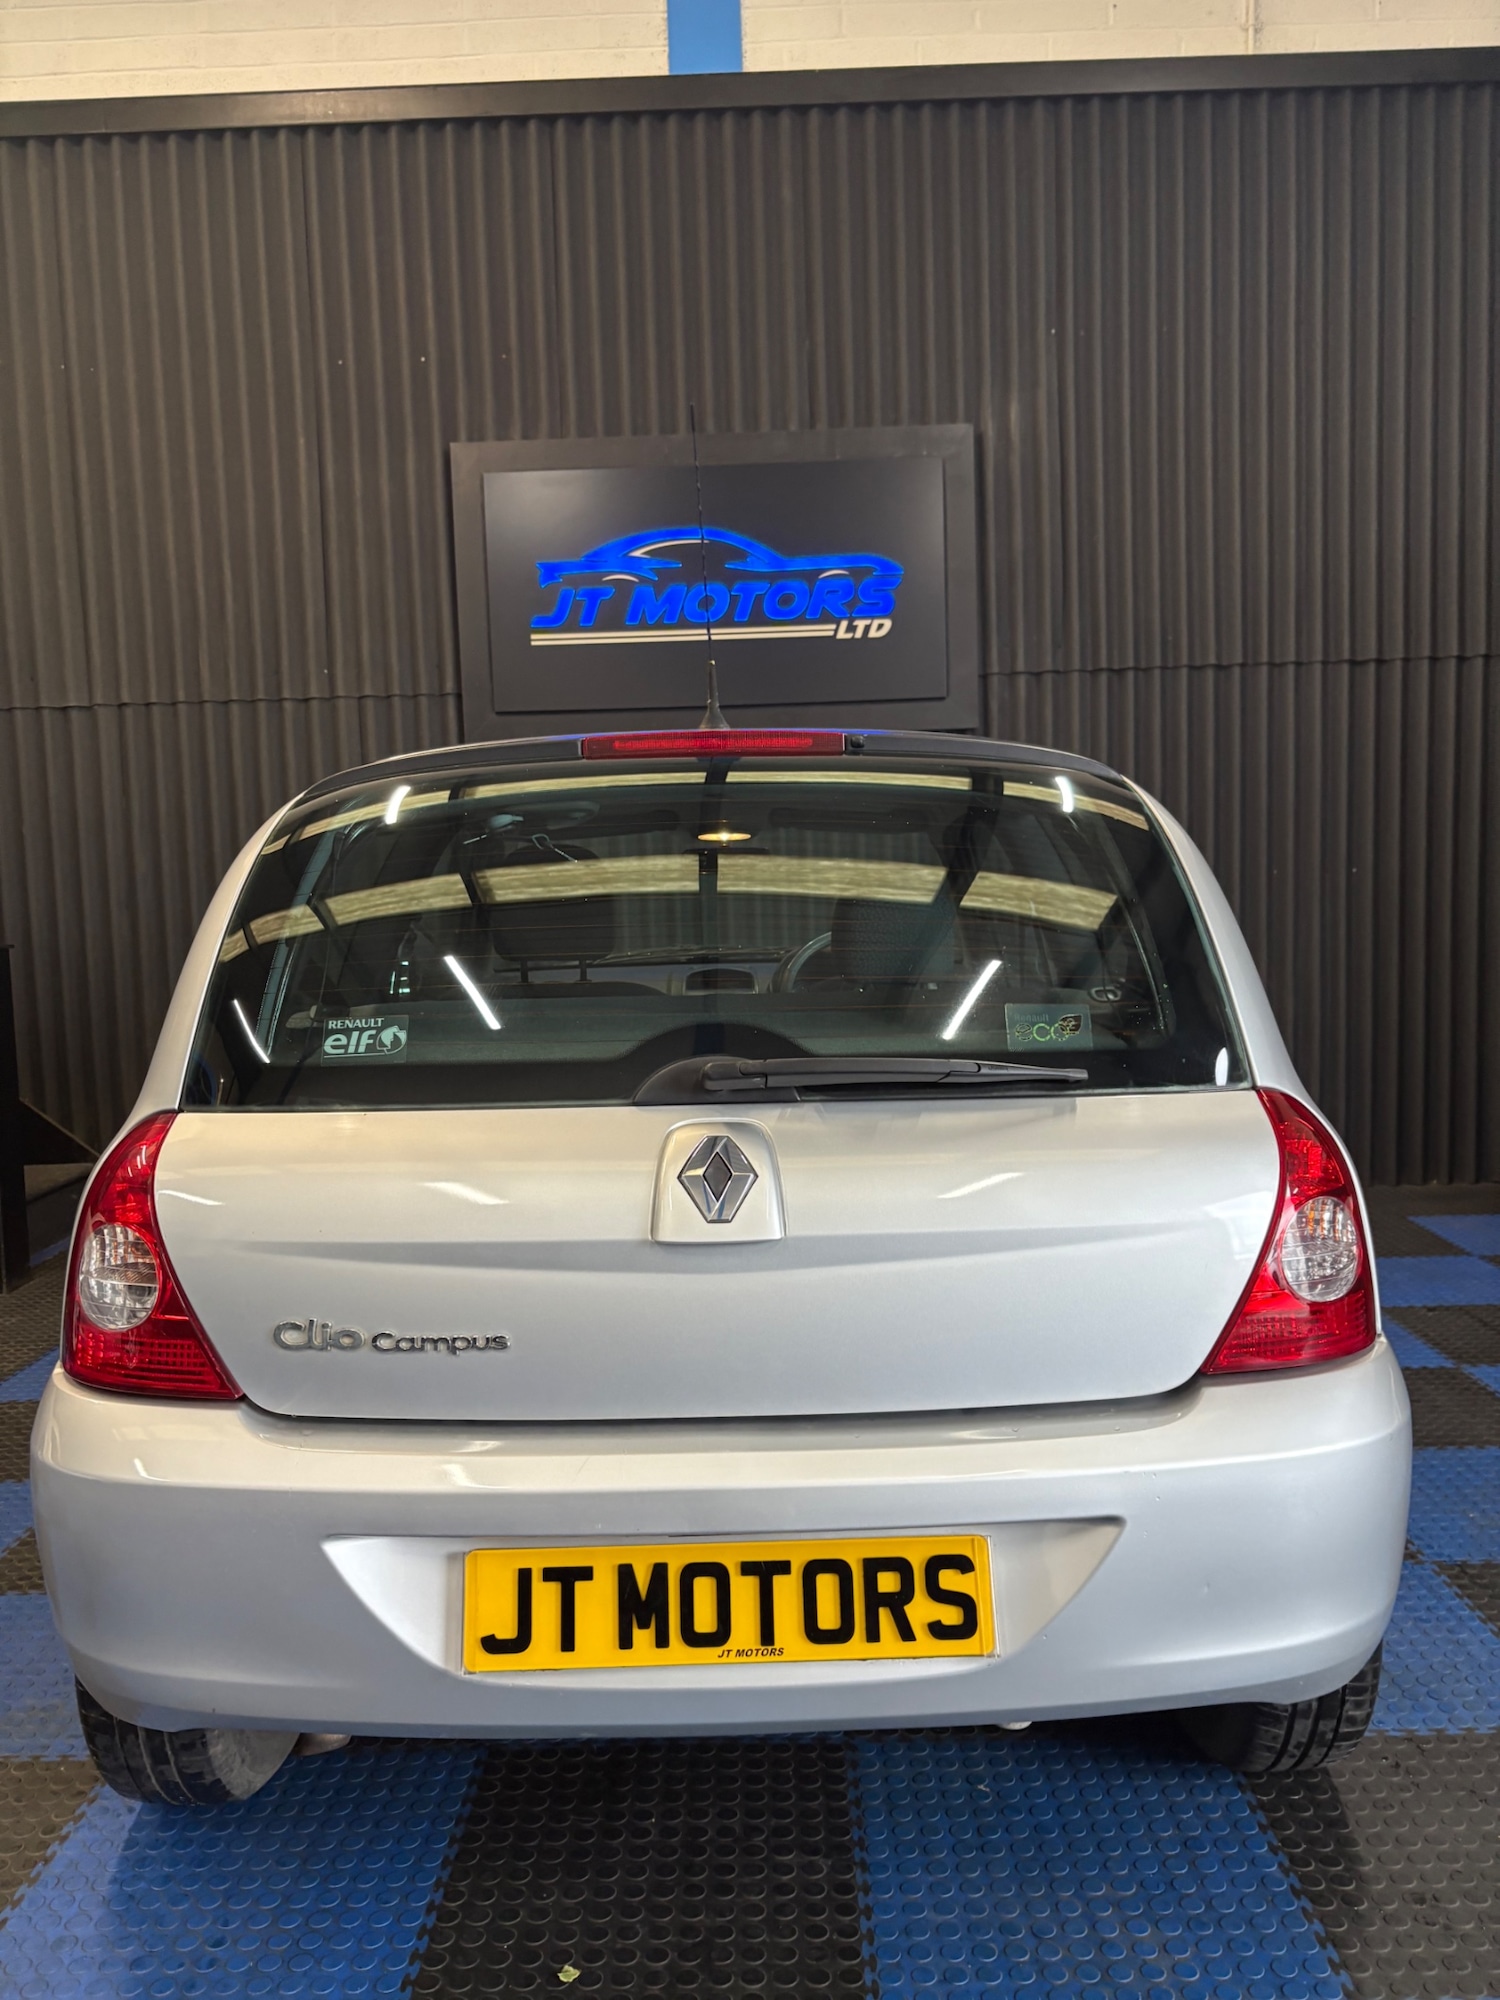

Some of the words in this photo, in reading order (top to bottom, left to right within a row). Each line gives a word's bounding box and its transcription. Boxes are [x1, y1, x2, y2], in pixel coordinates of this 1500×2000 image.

[530, 586, 615, 628] JT
[624, 576, 903, 625] MOTORS
[835, 618, 892, 640] LTD
[327, 1018, 385, 1029] RENAULT
[323, 1029, 377, 1055] elf
[273, 1317, 366, 1351] Clio
[370, 1330, 512, 1357] Campus
[480, 1565, 594, 1655] JT
[618, 1553, 979, 1650] MOTORS
[717, 1649, 733, 1658] JT
[735, 1647, 785, 1658] MOTORS
